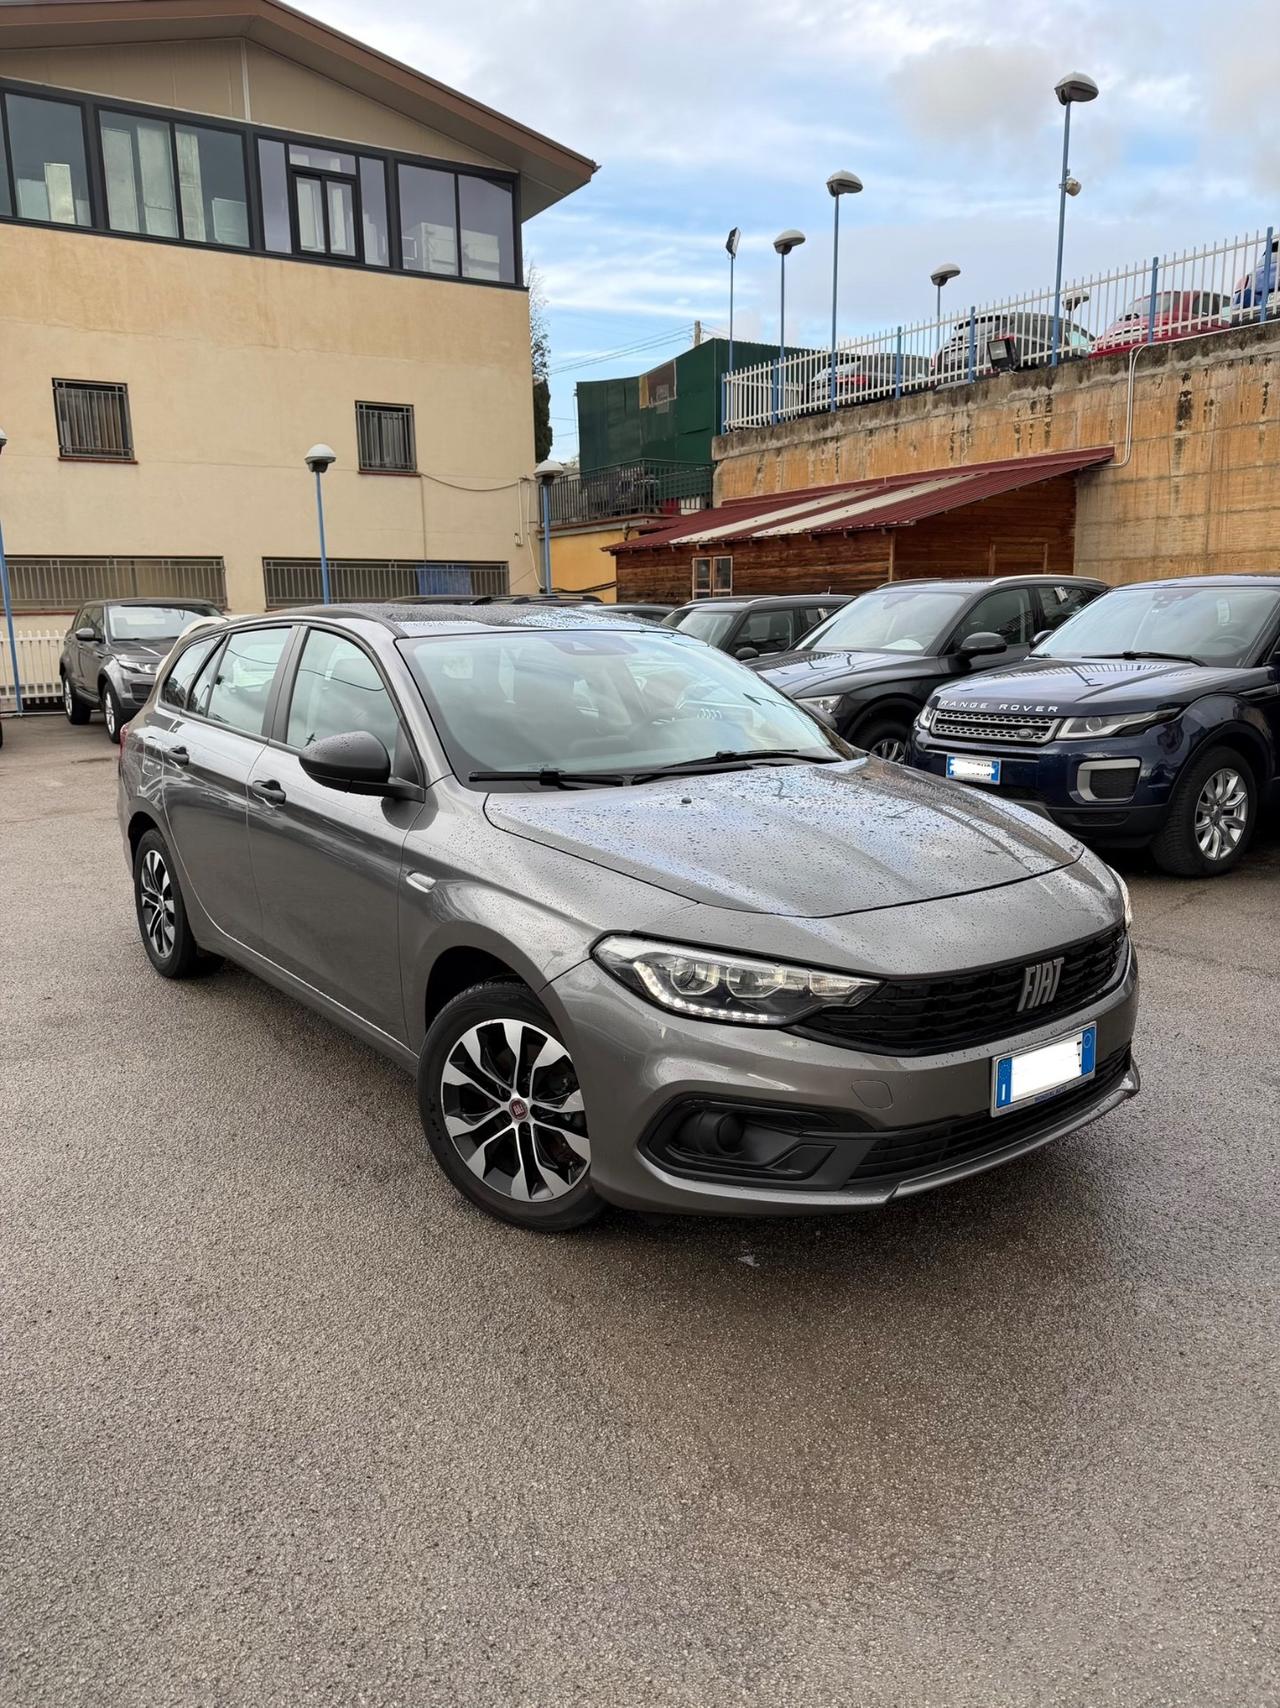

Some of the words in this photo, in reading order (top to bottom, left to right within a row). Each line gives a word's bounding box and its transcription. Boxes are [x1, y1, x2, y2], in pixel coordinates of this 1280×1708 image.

[941, 701, 989, 709] RANGE
[999, 704, 1059, 712] ROVER
[1017, 957, 1065, 1013] FIAT
[1001, 1083, 1006, 1101] I
